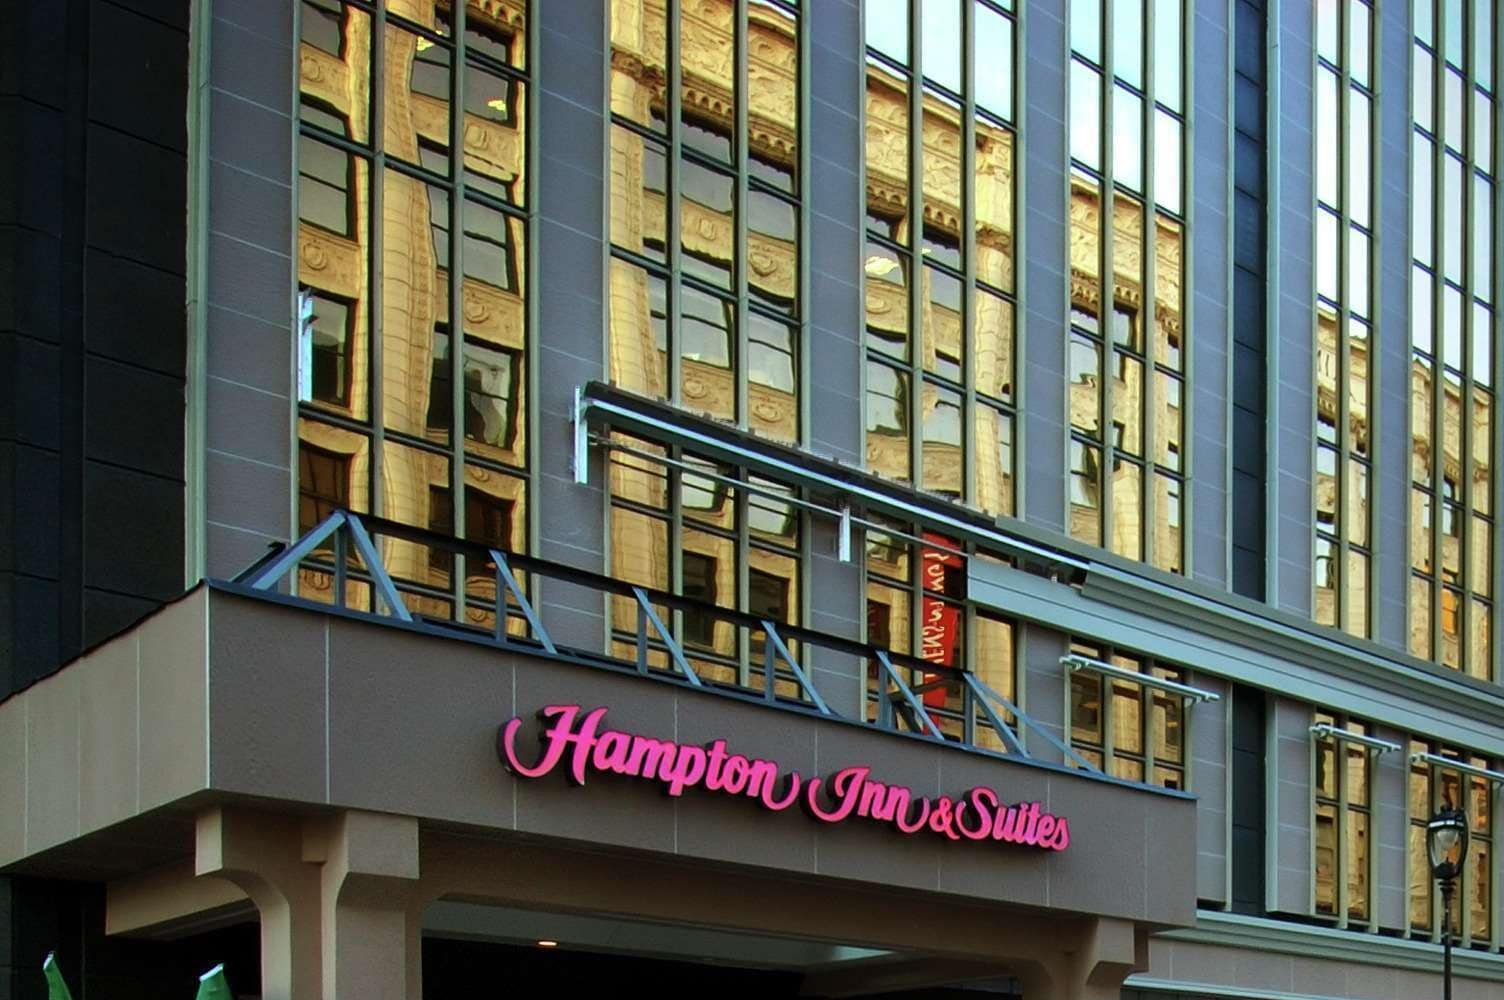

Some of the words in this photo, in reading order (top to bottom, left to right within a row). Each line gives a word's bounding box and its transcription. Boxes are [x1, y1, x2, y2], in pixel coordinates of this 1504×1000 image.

[503, 704, 800, 811] Hampton
[807, 766, 930, 834] Inn
[928, 796, 960, 841] &
[955, 786, 1070, 851] Suites
